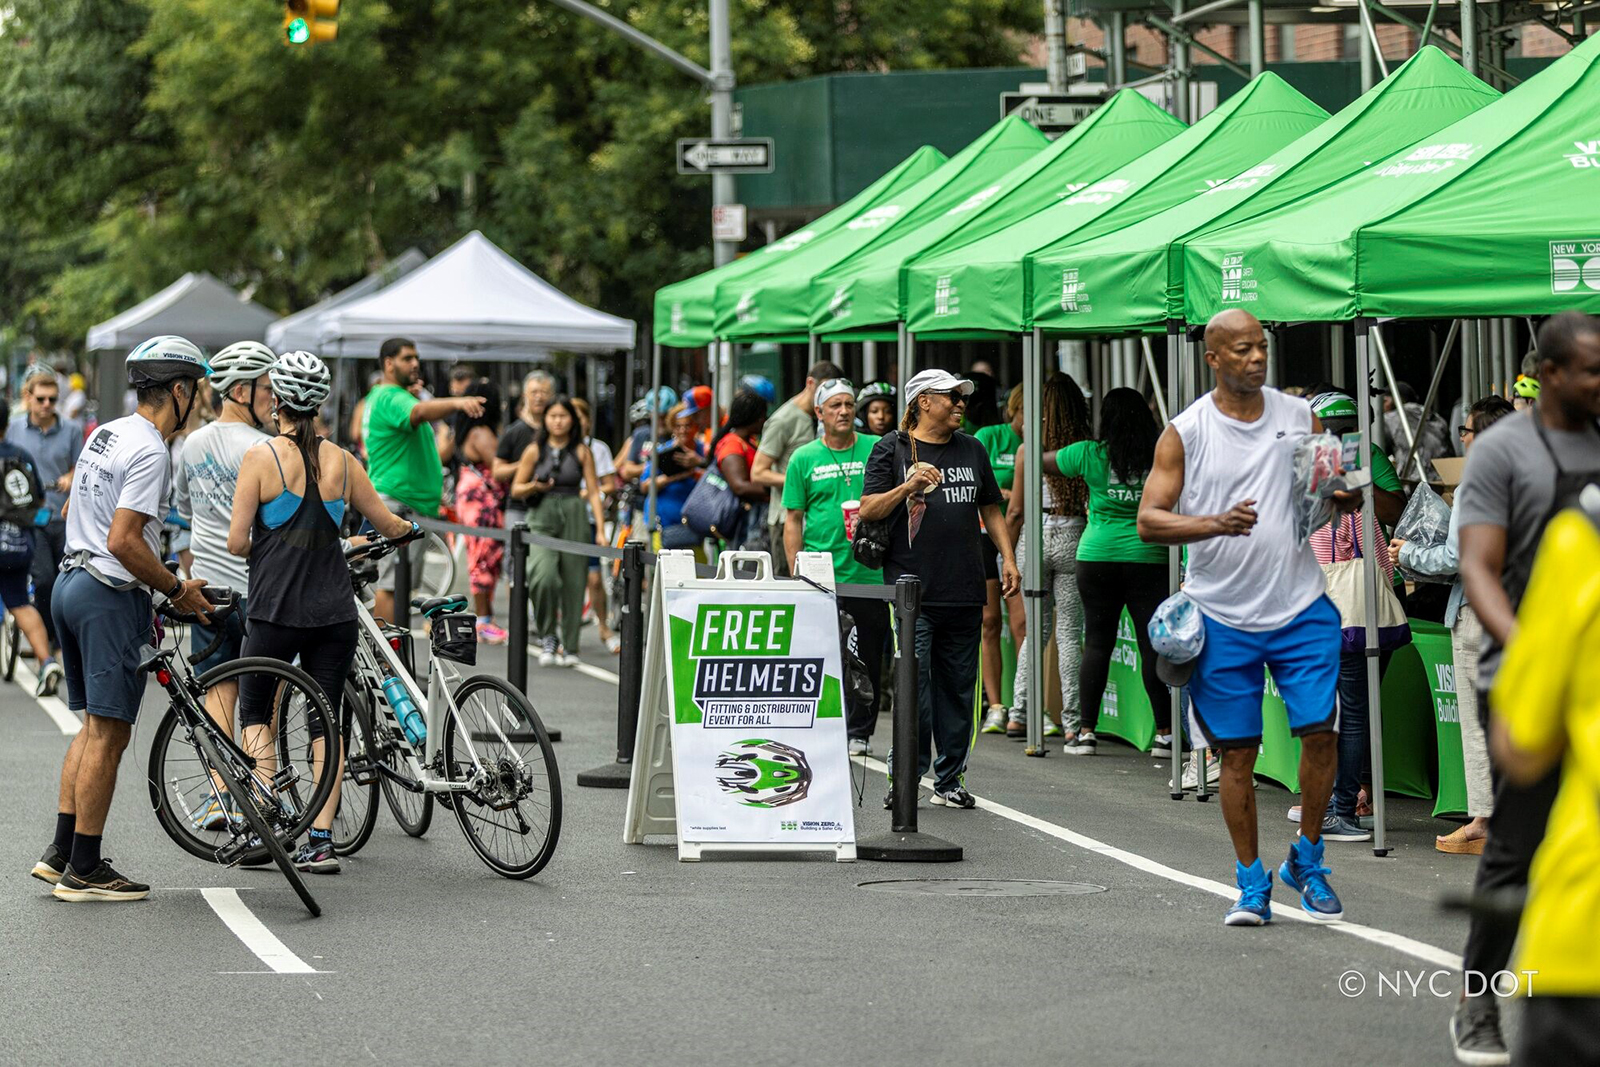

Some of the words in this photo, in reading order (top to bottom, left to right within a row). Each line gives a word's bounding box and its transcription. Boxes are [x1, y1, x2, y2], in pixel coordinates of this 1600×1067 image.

[1021, 106, 1057, 122] ONE
[1552, 244, 1575, 254] NEW
[163, 352, 183, 360] VISION
[813, 464, 840, 475] VISION
[841, 461, 864, 471] ZERO
[940, 468, 945, 484] I
[947, 467, 975, 483] SAW
[811, 471, 838, 482] Building
[942, 486, 977, 503] THAT!
[701, 610, 786, 651] FREE
[702, 663, 817, 693] HELMETS
[318, 692, 336, 724] KENDA
[710, 704, 743, 714] FITTING
[744, 704, 751, 713] &
[752, 703, 811, 714] DISTRIBUTION
[708, 715, 737, 725] EVENT
[737, 715, 754, 725] FOR
[756, 715, 772, 725] ALL
